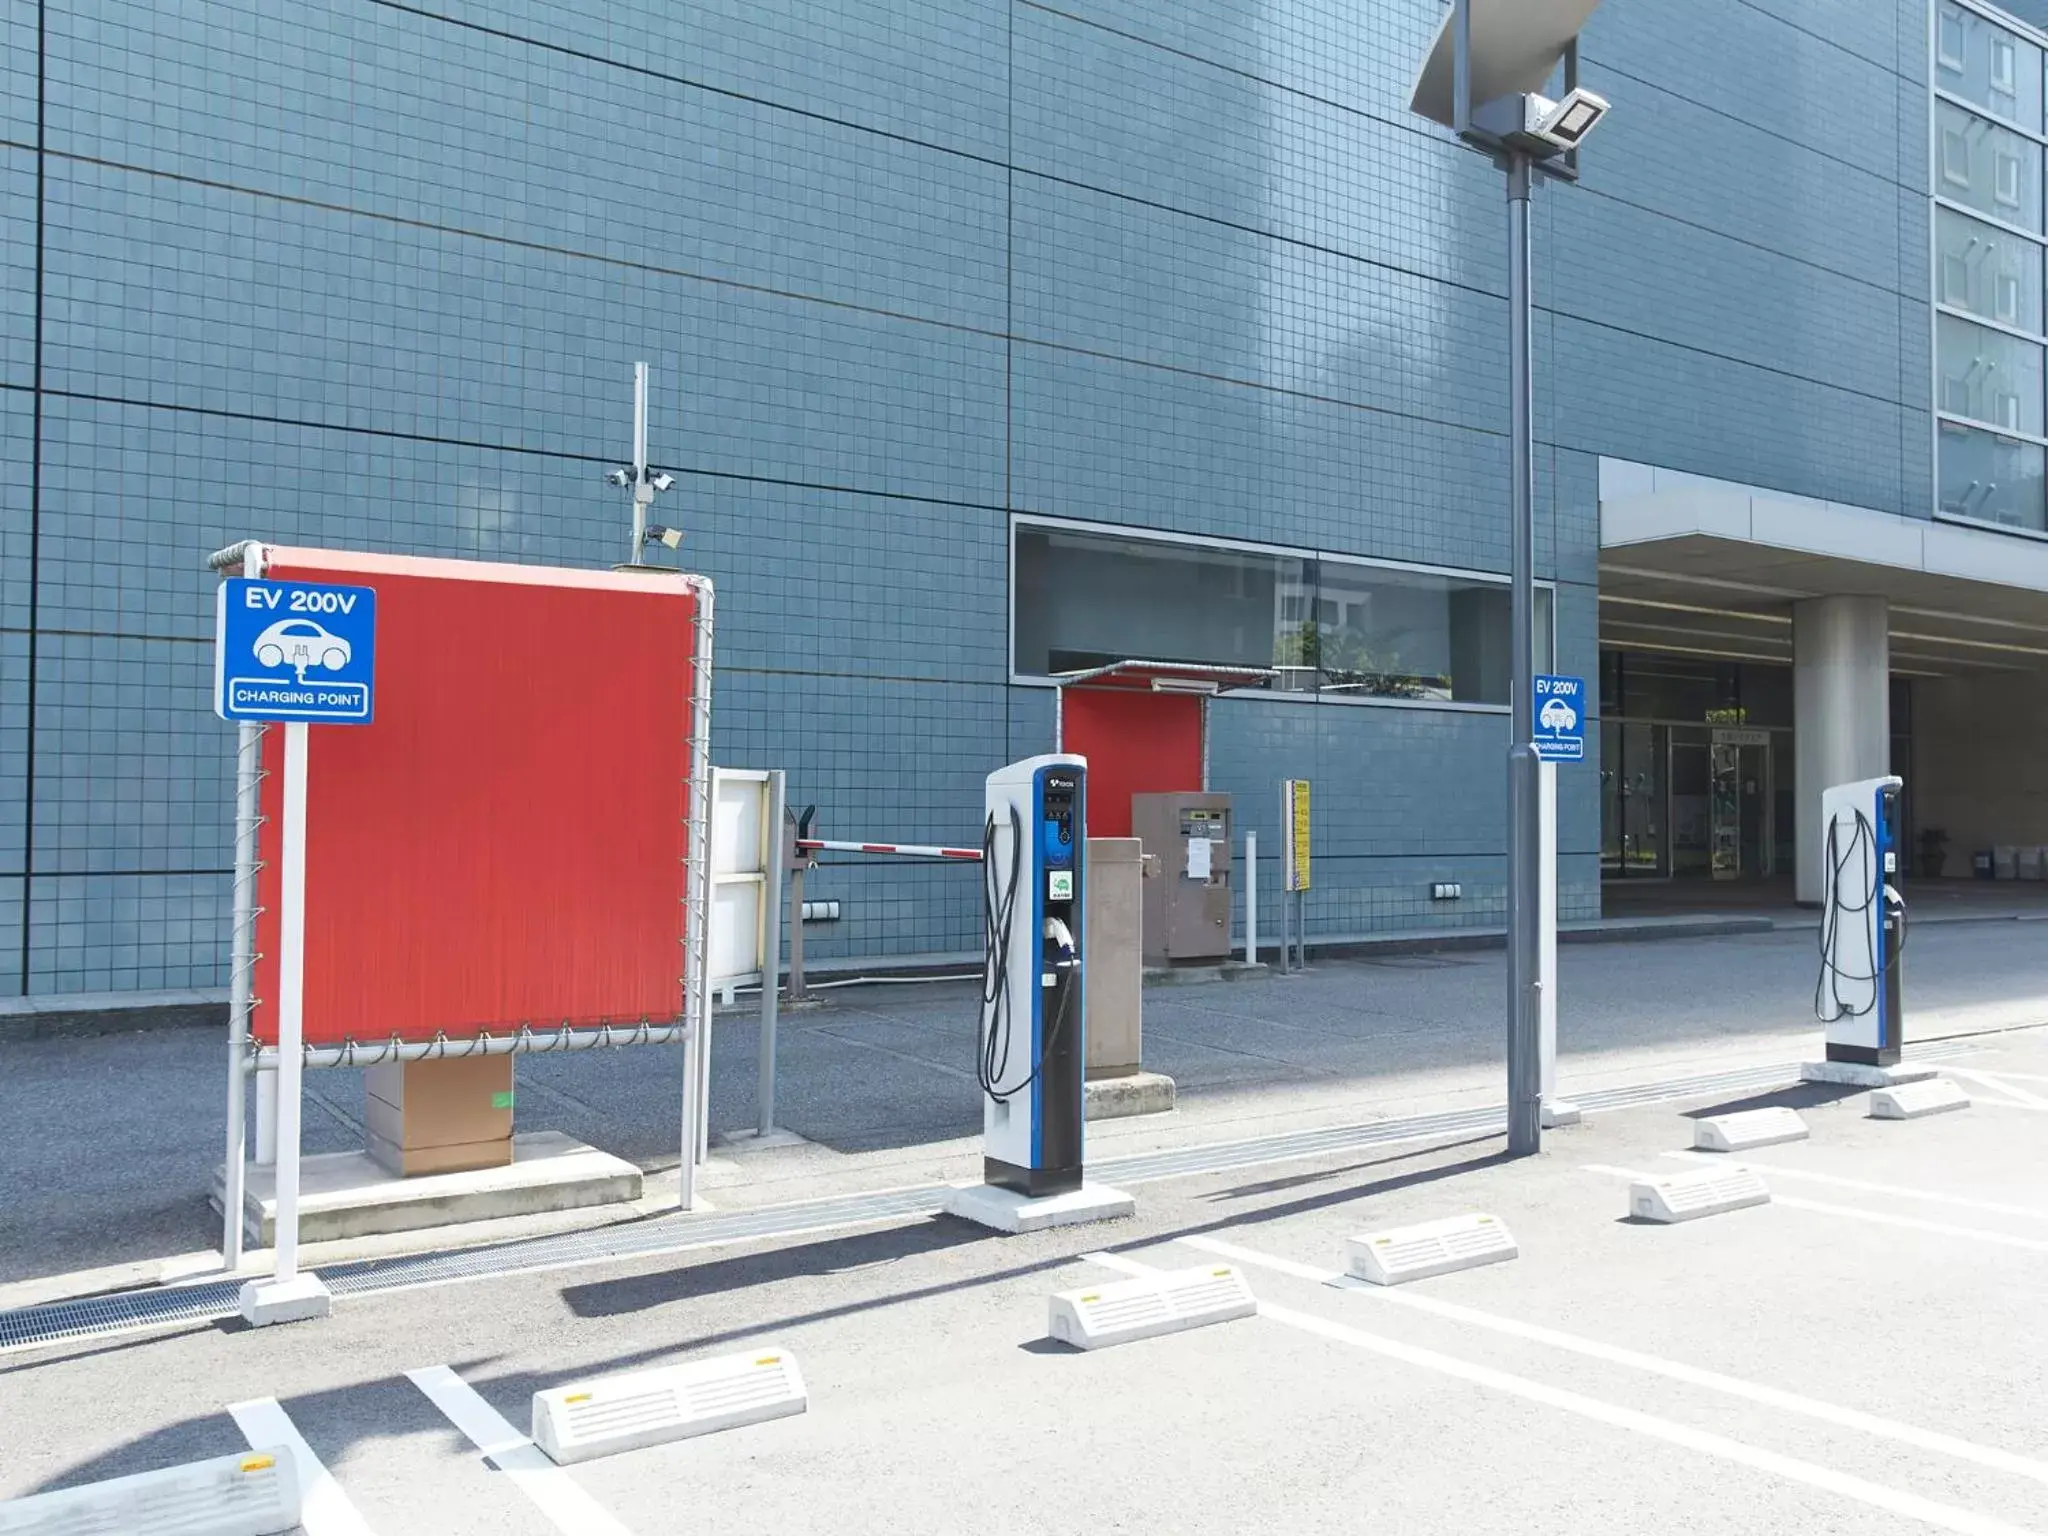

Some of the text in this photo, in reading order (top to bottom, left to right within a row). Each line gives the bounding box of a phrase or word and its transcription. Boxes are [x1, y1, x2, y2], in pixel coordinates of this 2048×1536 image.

[246, 587, 357, 614] EV 200V
[1537, 680, 1578, 695] EV 200V
[237, 690, 361, 706] CHARGING POINT
